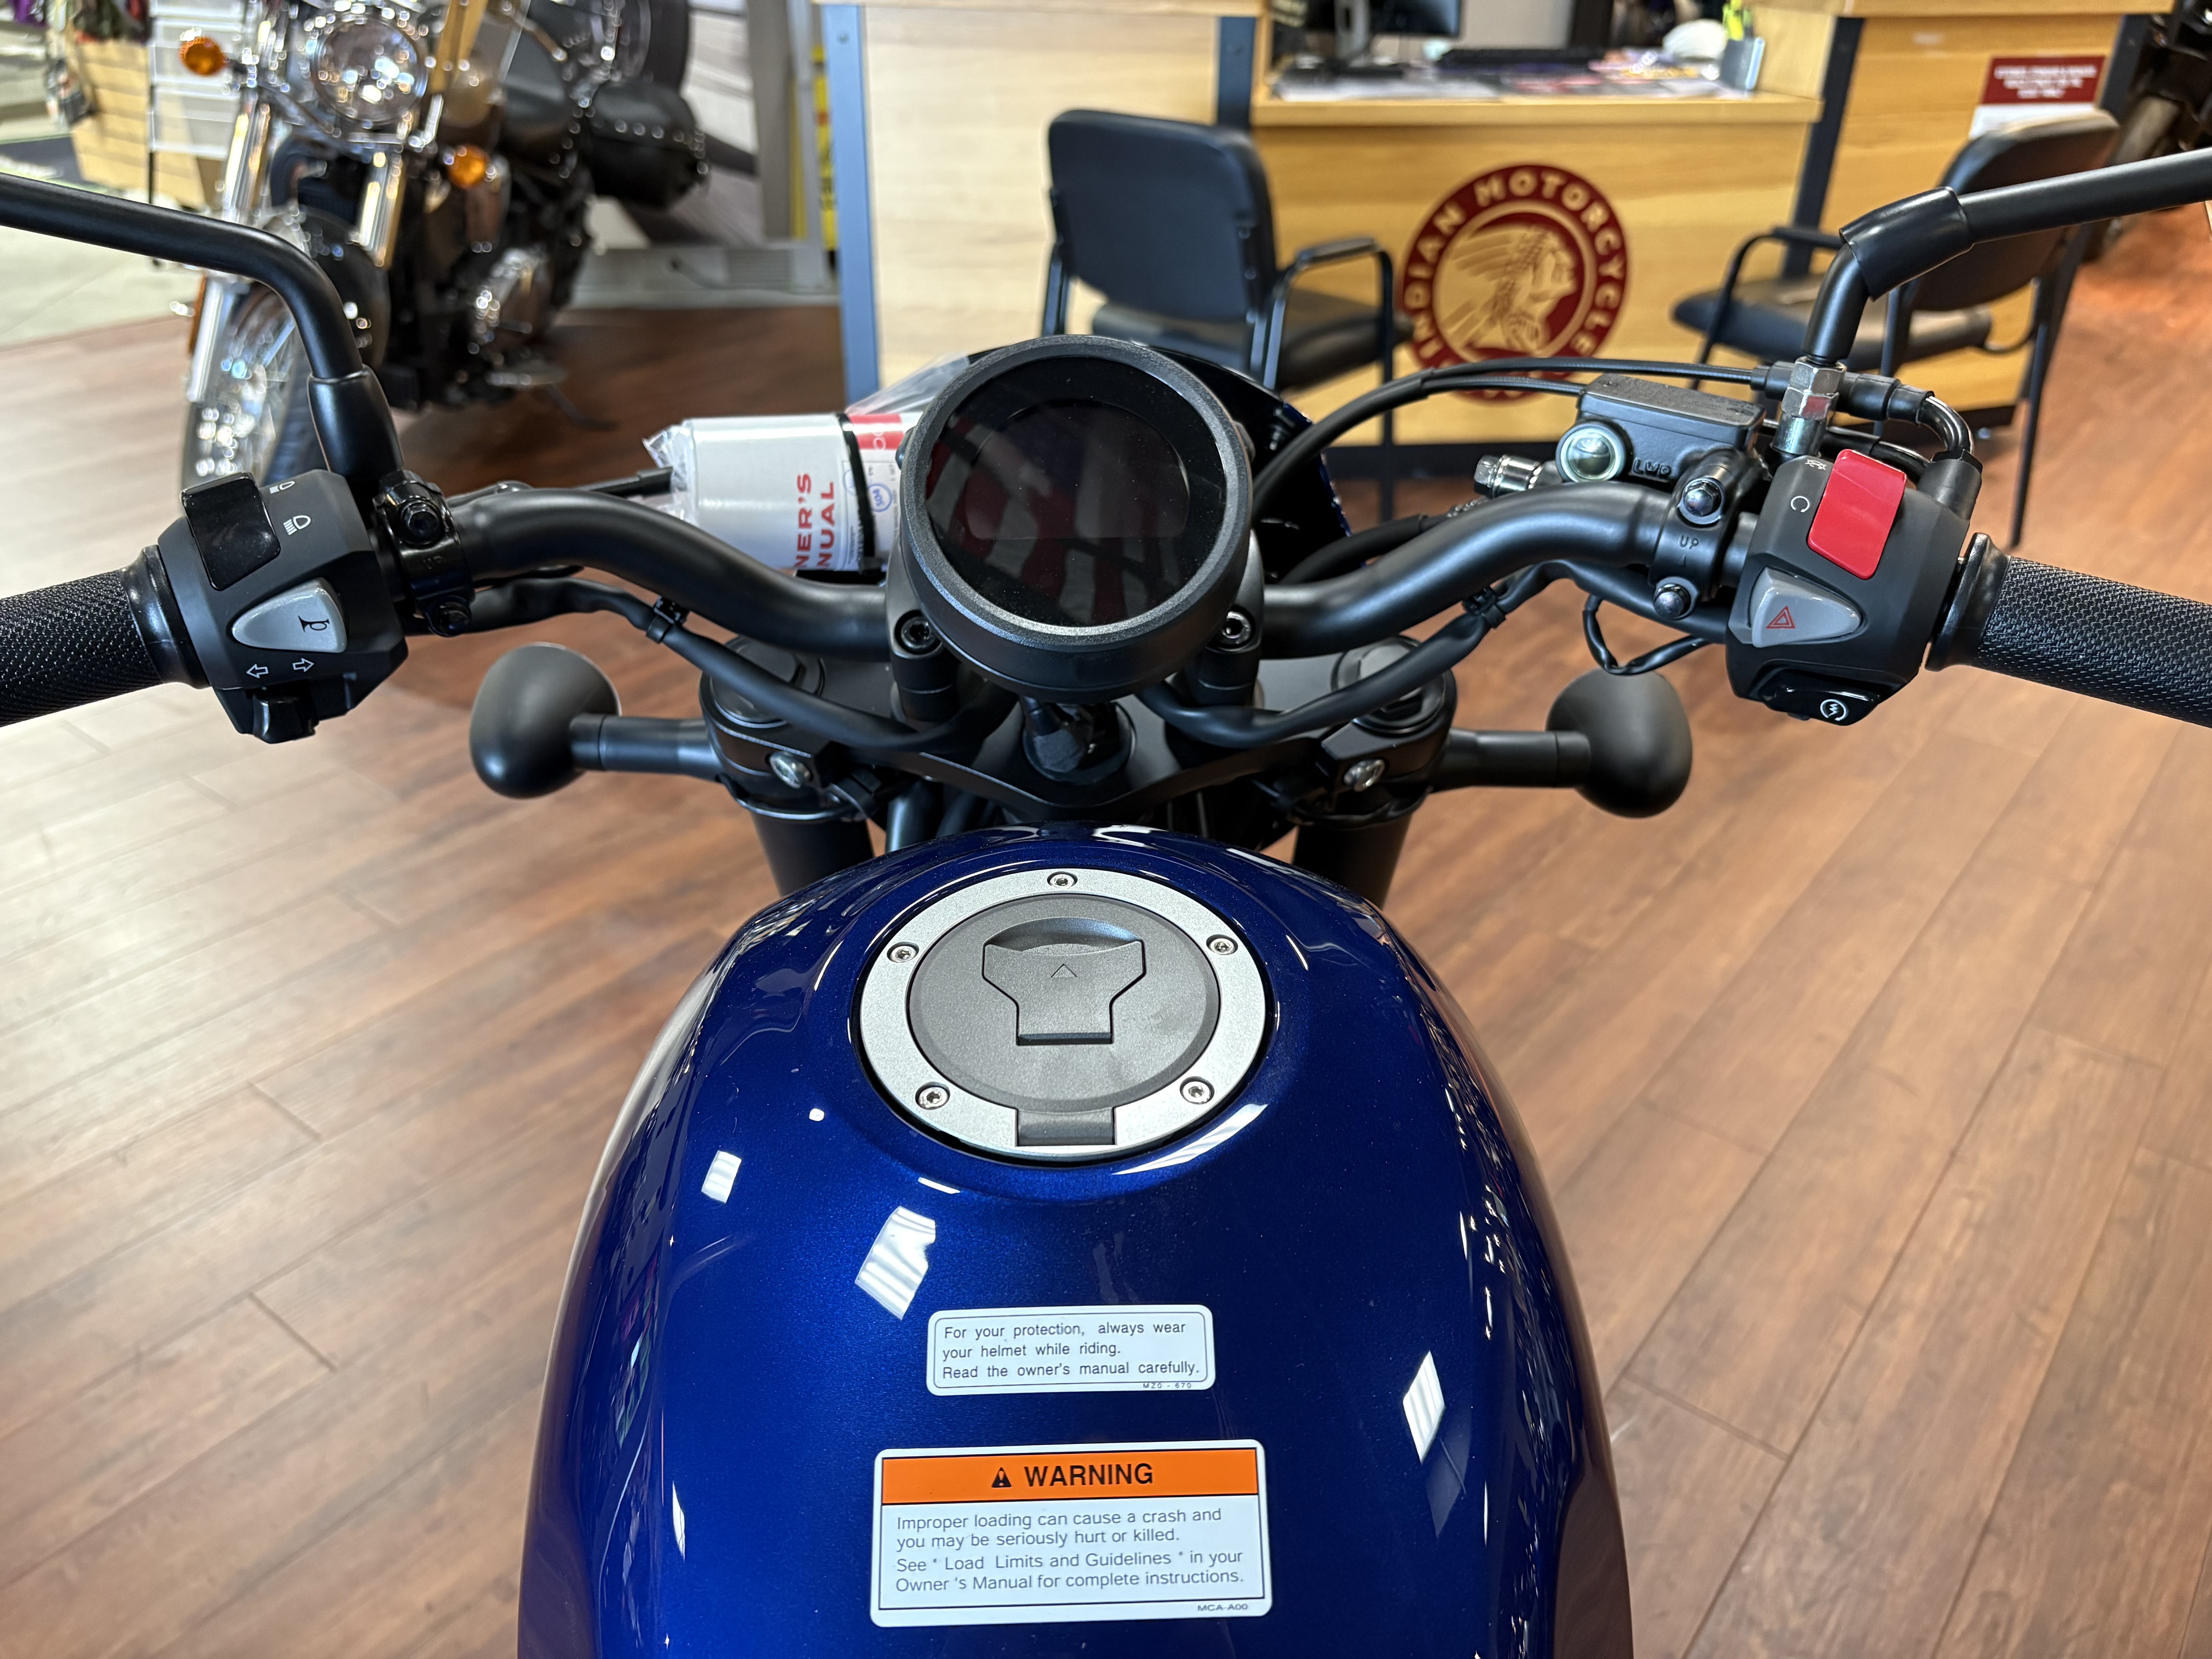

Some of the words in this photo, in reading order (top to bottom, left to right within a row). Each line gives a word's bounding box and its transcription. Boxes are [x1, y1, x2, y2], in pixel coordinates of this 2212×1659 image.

[1404, 201, 1467, 359] INDIAN
[1473, 168, 1625, 356] MOTORCYCLE
[1678, 534, 1699, 550] UP
[945, 1327, 967, 1338] For
[975, 1328, 1005, 1341] your
[1013, 1322, 1084, 1339] protection,
[1098, 1322, 1144, 1336] always
[1153, 1324, 1185, 1333] wear
[943, 1348, 972, 1361] your
[981, 1345, 1027, 1357] helmet
[1035, 1343, 1070, 1355] while
[1080, 1342, 1120, 1357] riding.
[943, 1366, 978, 1379] Read
[987, 1365, 1008, 1377] the
[1017, 1363, 1070, 1376] owner's
[1080, 1362, 1129, 1374] manual
[1139, 1361, 1199, 1376] carefully.
[1024, 1463, 1152, 1487] WARNING
[898, 1517, 969, 1531] Improper
[974, 1513, 1032, 1527] loading
[1038, 1515, 1067, 1525] can
[1073, 1513, 1121, 1525] cause
[1127, 1513, 1136, 1523] a
[1142, 1509, 1186, 1523] crash
[1192, 1508, 1221, 1521] and
[896, 1538, 925, 1551] you
[931, 1537, 965, 1550] may
[971, 1533, 989, 1546] be
[996, 1531, 1068, 1547] seriously
[1075, 1530, 1106, 1543] hurt
[1111, 1532, 1128, 1542] or
[1133, 1528, 1180, 1542] killed.
[897, 1558, 927, 1572] See
[945, 1556, 984, 1570] Load
[996, 1554, 1043, 1568] Limits
[1049, 1554, 1079, 1567] and
[1085, 1552, 1171, 1566] Guidelines
[1190, 1550, 1203, 1563] in
[1209, 1552, 1243, 1567] your
[973, 1575, 1032, 1589] Manual
[1037, 1574, 1061, 1588] for
[1066, 1572, 1140, 1588] complete
[1146, 1570, 1243, 1585] instructions.
